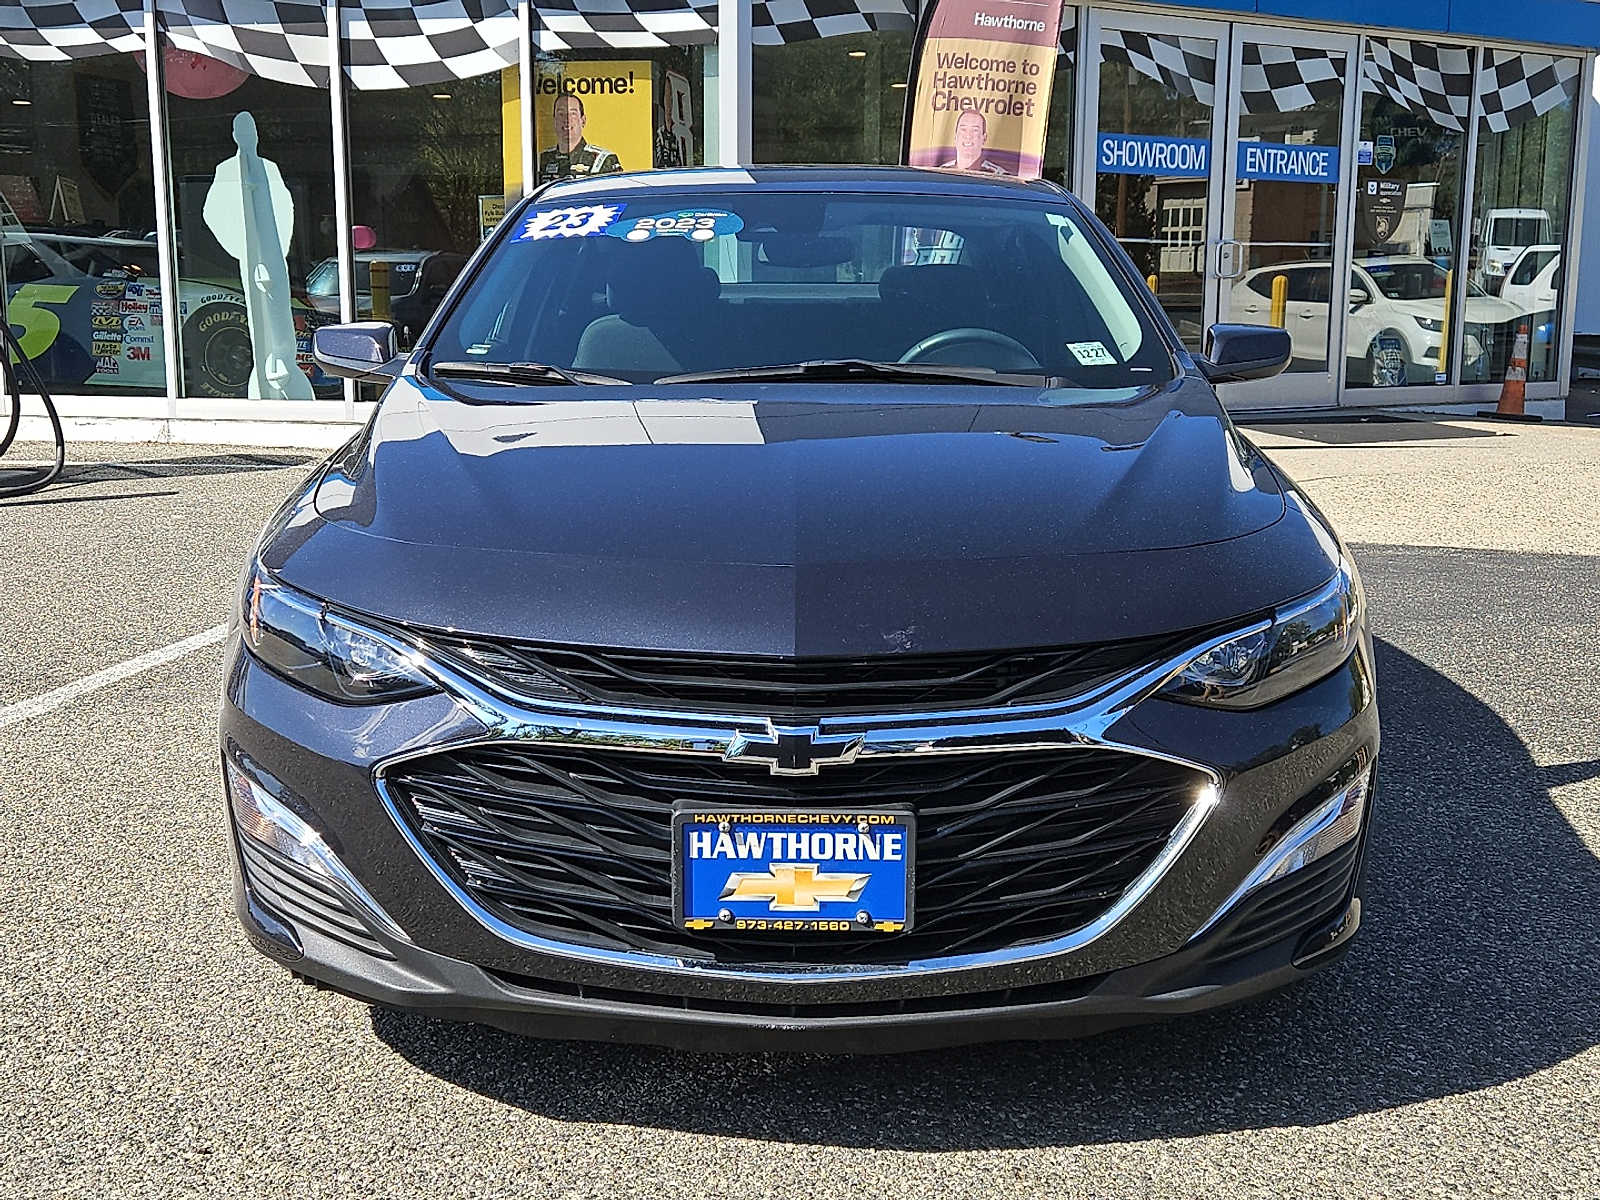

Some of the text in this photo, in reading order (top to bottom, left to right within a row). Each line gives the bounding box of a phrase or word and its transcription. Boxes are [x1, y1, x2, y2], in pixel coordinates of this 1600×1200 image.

[974, 11, 1046, 32] Hawthorne
[936, 52, 1040, 76] Welcome to
[932, 71, 1037, 96] Hawthorne
[931, 90, 1036, 118] Chevrolet
[1101, 139, 1206, 171] SHOWROOM
[1245, 147, 1329, 177] ENTRANCE
[540, 211, 595, 231] 23
[634, 217, 716, 230] 2023
[121, 301, 148, 313] Holley
[200, 293, 244, 304] GOODY
[199, 311, 248, 331] GOODY
[92, 330, 122, 341] Gillette
[126, 346, 151, 361] 3M
[694, 814, 896, 825] HAWTHORNECHEVY.COM
[689, 830, 903, 861] HAWTHORNE
